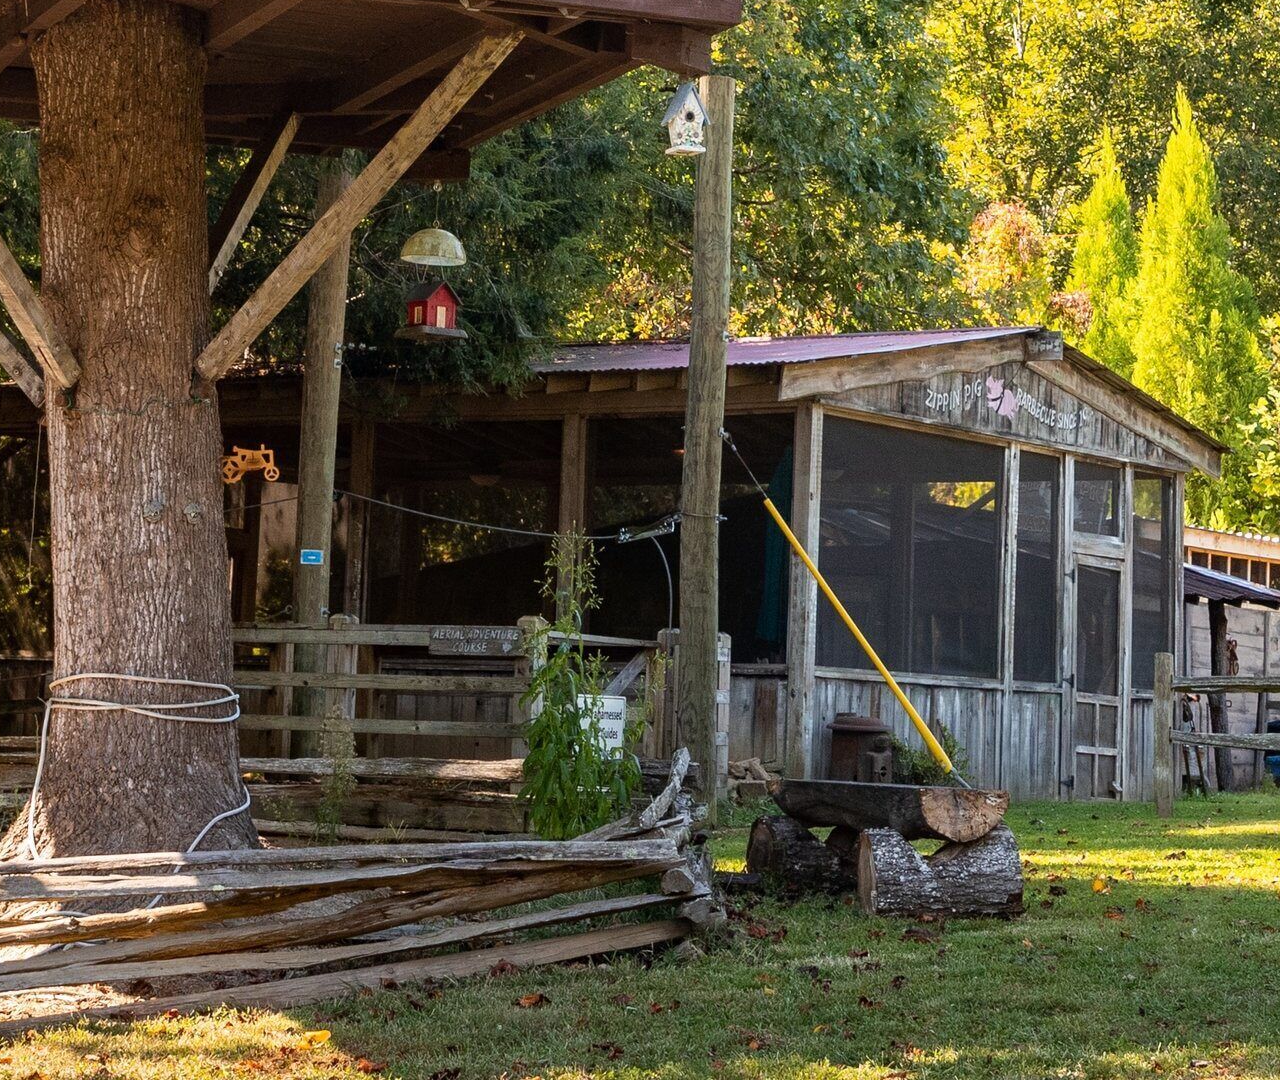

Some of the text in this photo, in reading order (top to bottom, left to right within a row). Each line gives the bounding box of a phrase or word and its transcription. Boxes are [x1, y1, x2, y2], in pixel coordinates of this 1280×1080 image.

[925, 388, 961, 412] ZIPPIN
[964, 379, 982, 402] PIG
[1016, 388, 1055, 427] BARBECUE
[1057, 412, 1077, 429] SINCE
[432, 629, 519, 640] AERIAL ADVENTURE
[453, 642, 488, 652] COURSE
